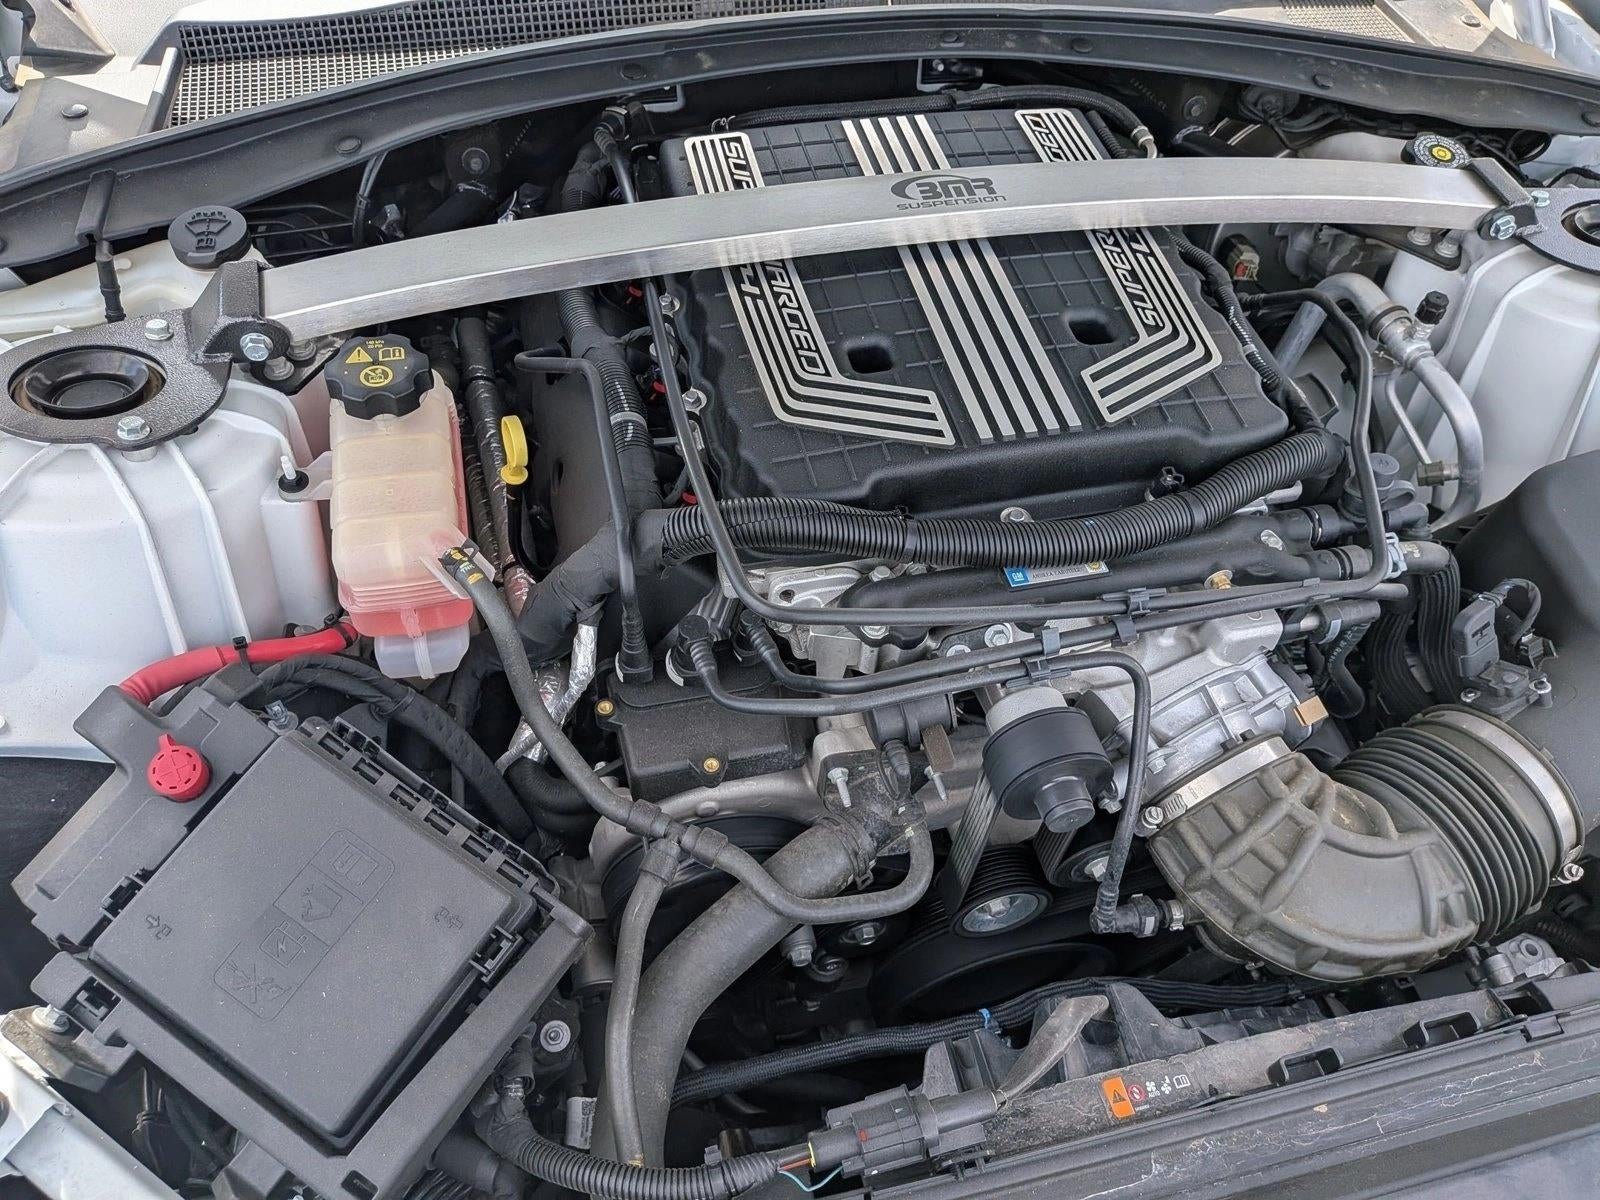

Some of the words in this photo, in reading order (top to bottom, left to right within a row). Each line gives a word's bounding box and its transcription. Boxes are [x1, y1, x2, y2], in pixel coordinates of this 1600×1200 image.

[912, 177, 998, 201] BMR
[896, 194, 1008, 211] SUSPENSION
[1095, 230, 1164, 328] SUPER
[1011, 571, 1025, 581] GM
